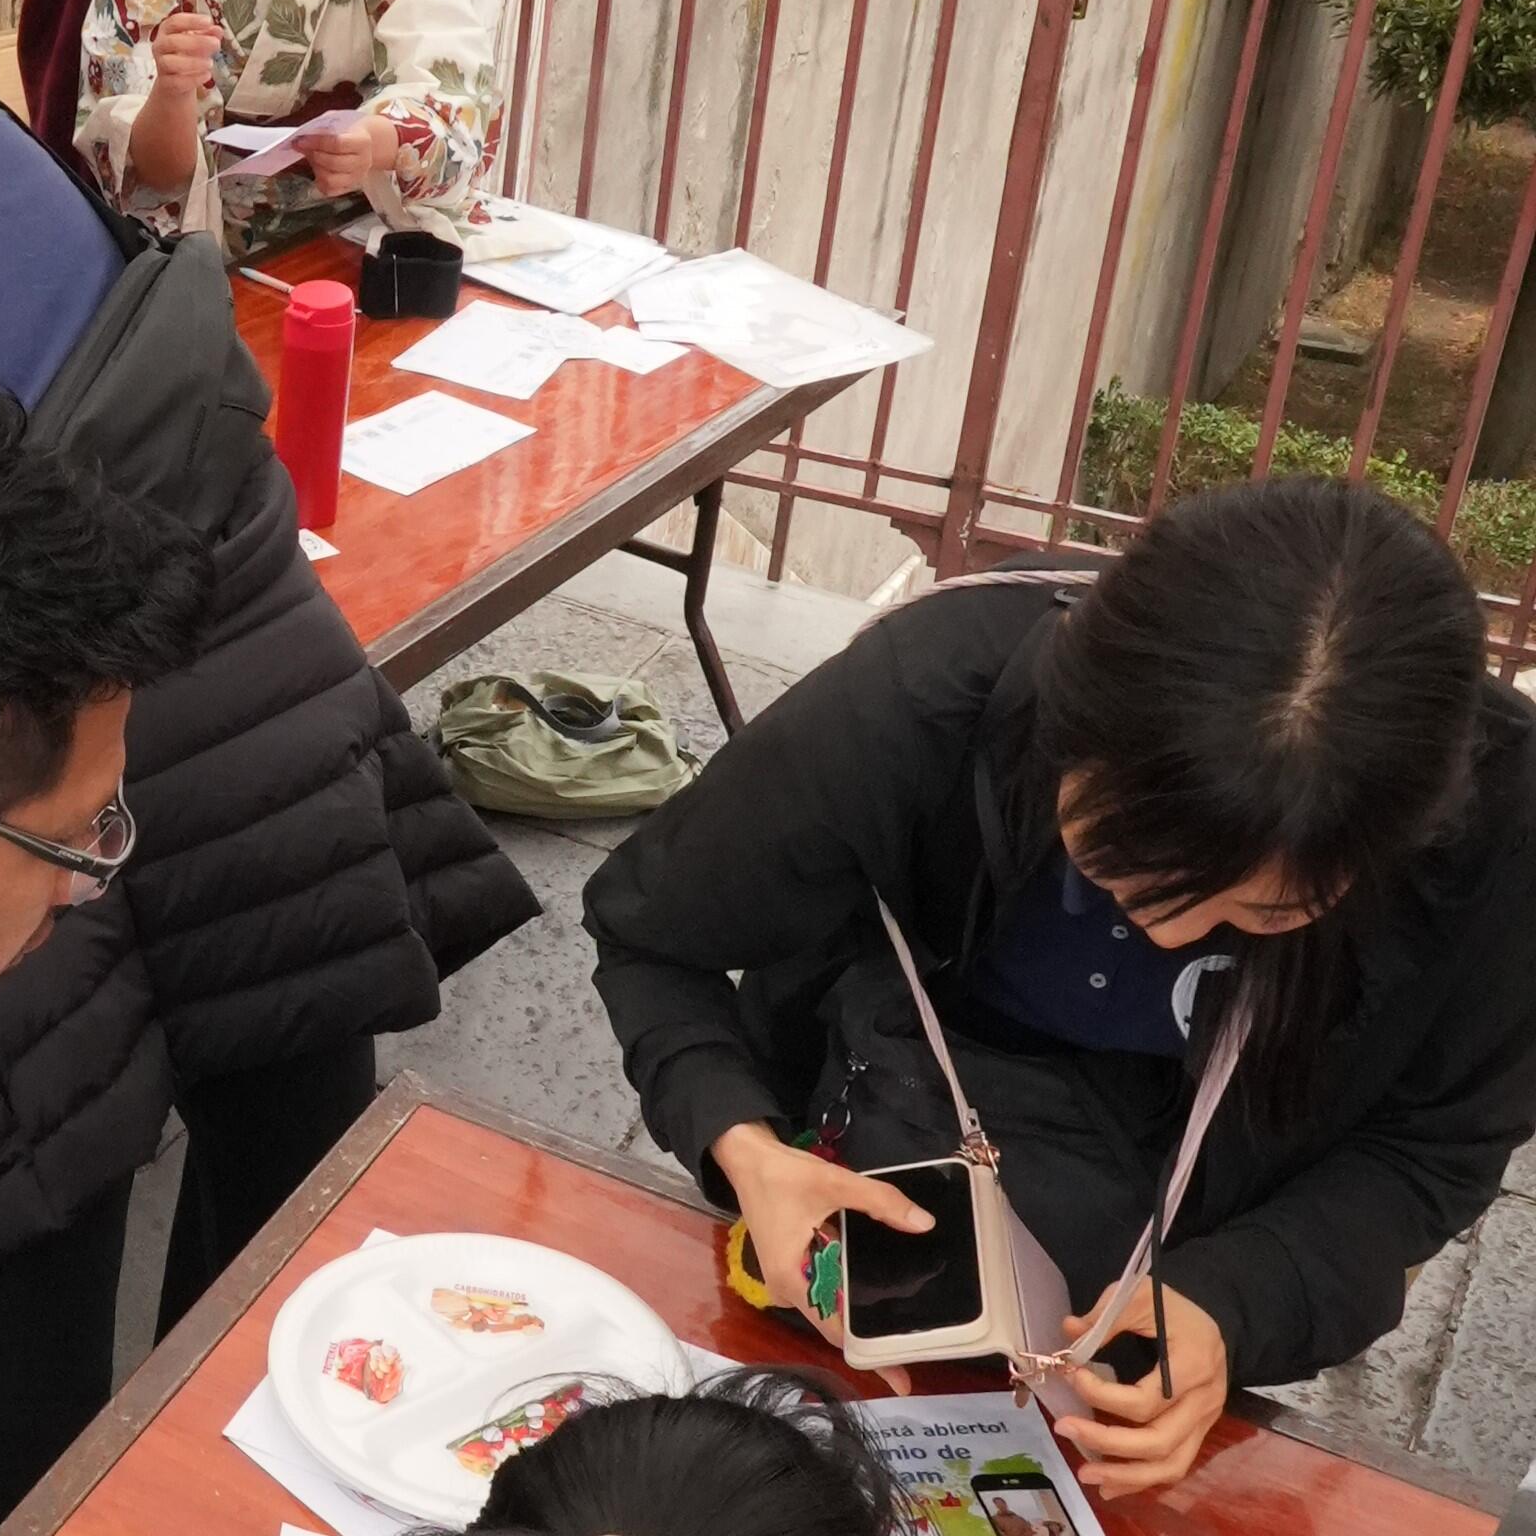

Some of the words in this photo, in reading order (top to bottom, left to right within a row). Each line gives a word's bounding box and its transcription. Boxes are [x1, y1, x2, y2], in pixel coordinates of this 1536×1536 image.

[923, 1420, 1008, 1439] abierto!
[882, 1444, 927, 1462] mio
[938, 1444, 973, 1461] de
[900, 1469, 945, 1485] am
